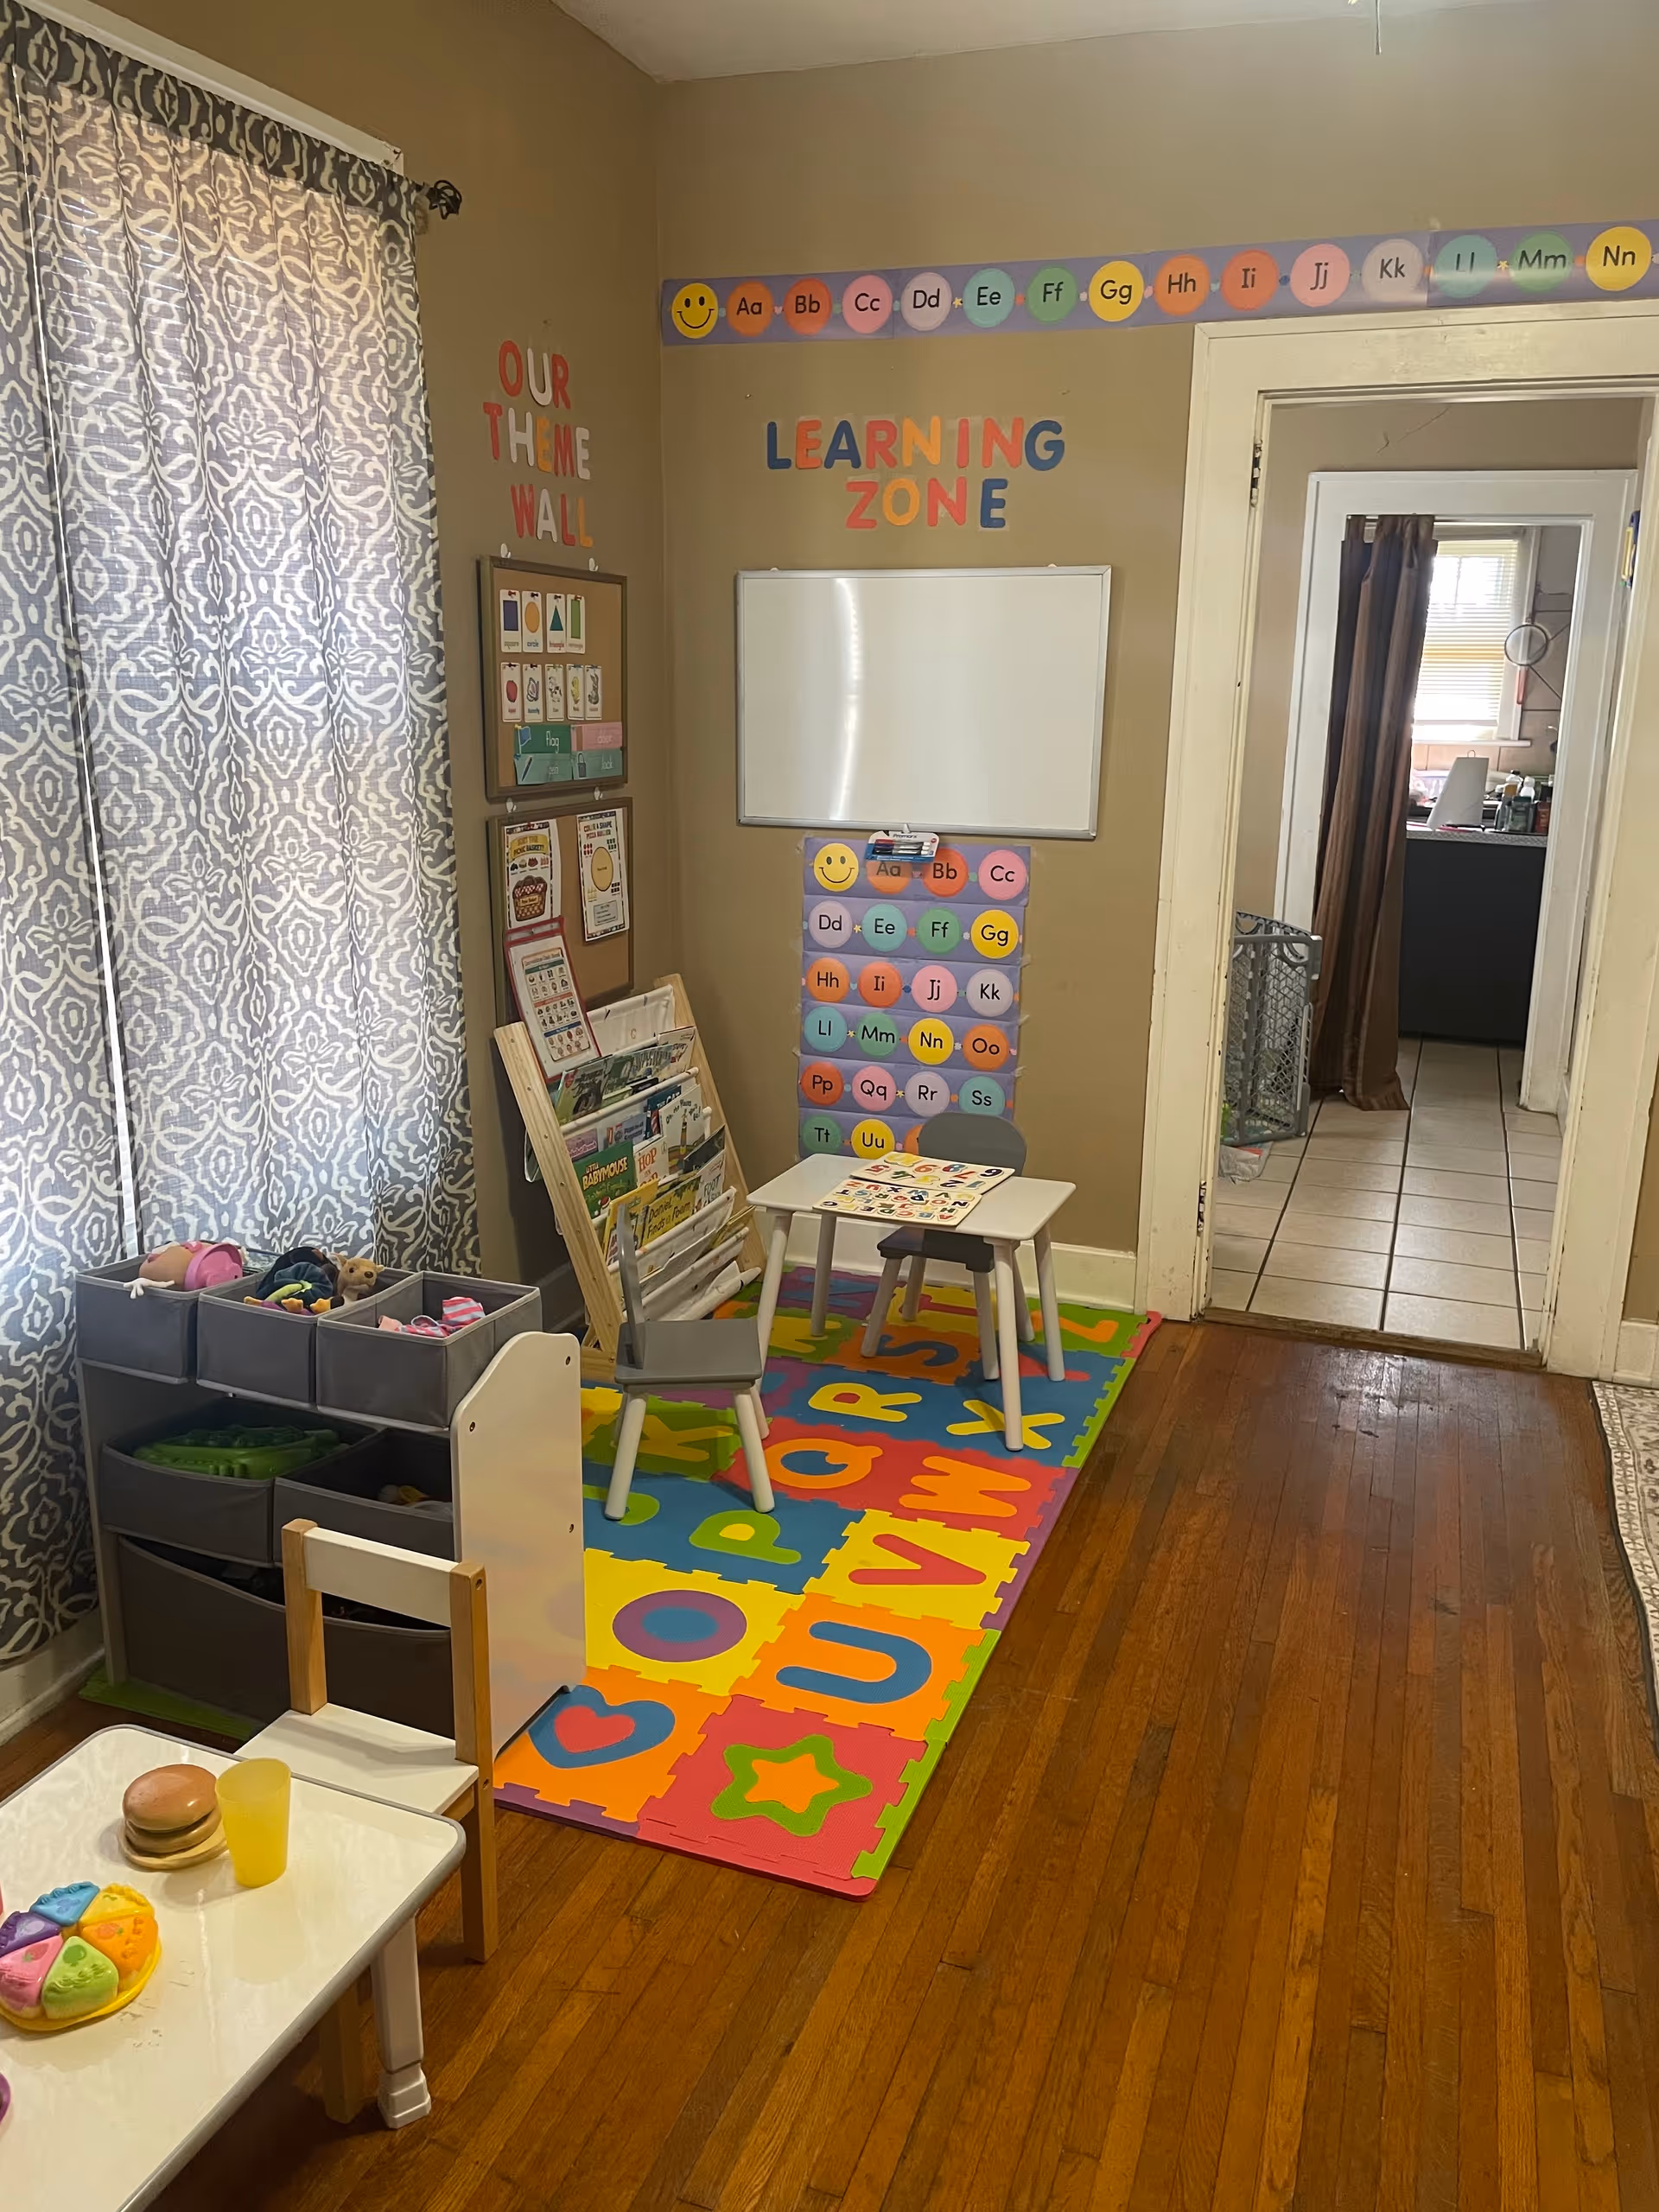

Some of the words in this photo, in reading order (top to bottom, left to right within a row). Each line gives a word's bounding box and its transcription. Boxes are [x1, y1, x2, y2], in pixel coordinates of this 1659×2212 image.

[737, 298, 762, 315] Aa
[795, 295, 820, 314] Bb
[855, 294, 880, 312] Cc
[913, 289, 940, 308] Dd
[976, 286, 1001, 306] Ee
[1042, 282, 1064, 302] Ff
[1100, 279, 1132, 304] Gg
[1167, 273, 1196, 294] Hh
[1241, 268, 1255, 289] Ii
[1310, 263, 1328, 290] Jj
[1380, 257, 1405, 279] Kk
[1456, 252, 1474, 272] Ll
[1518, 250, 1566, 271] Mm
[1603, 245, 1636, 266] Nn
[499, 340, 571, 409] OUR
[483, 402, 590, 480] THEME
[766, 416, 1065, 471] LEARNING
[511, 484, 593, 548] WALL
[846, 476, 1008, 530] ZONE
[546, 730, 560, 754] flag
[876, 861, 900, 876] Aa
[933, 862, 957, 880] Bb
[990, 865, 1014, 881] Cc
[819, 915, 842, 931] Dd
[874, 918, 895, 934] Ee
[931, 922, 949, 938] Ff
[981, 925, 1008, 946] Gg
[817, 971, 839, 988] Hh
[874, 976, 885, 991] Ii
[927, 980, 940, 1001] Jj
[980, 983, 1001, 1000] Kk
[818, 1020, 830, 1036] Ll
[861, 1026, 895, 1043] Mm
[920, 1033, 943, 1048] Nn
[972, 1038, 1000, 1055] Oo
[812, 1075, 833, 1095] Pp
[860, 1080, 887, 1101] Qq
[918, 1085, 938, 1101] Rr
[972, 1090, 992, 1106] Ss
[815, 1128, 830, 1143] Tt
[861, 1132, 885, 1148] Uu
[582, 1156, 628, 1191] BABYMOUSE
[638, 1147, 657, 1173] HOP
[647, 1217, 665, 1239] Finds
[672, 1202, 691, 1221] Poem
[649, 1197, 672, 1224] Daniel
[808, 1382, 922, 1422] R
[766, 1439, 883, 1489] Q
[689, 1510, 802, 1565] P
[849, 1534, 987, 1586] V
[612, 1590, 747, 1662] O
[776, 1621, 932, 1705] U
